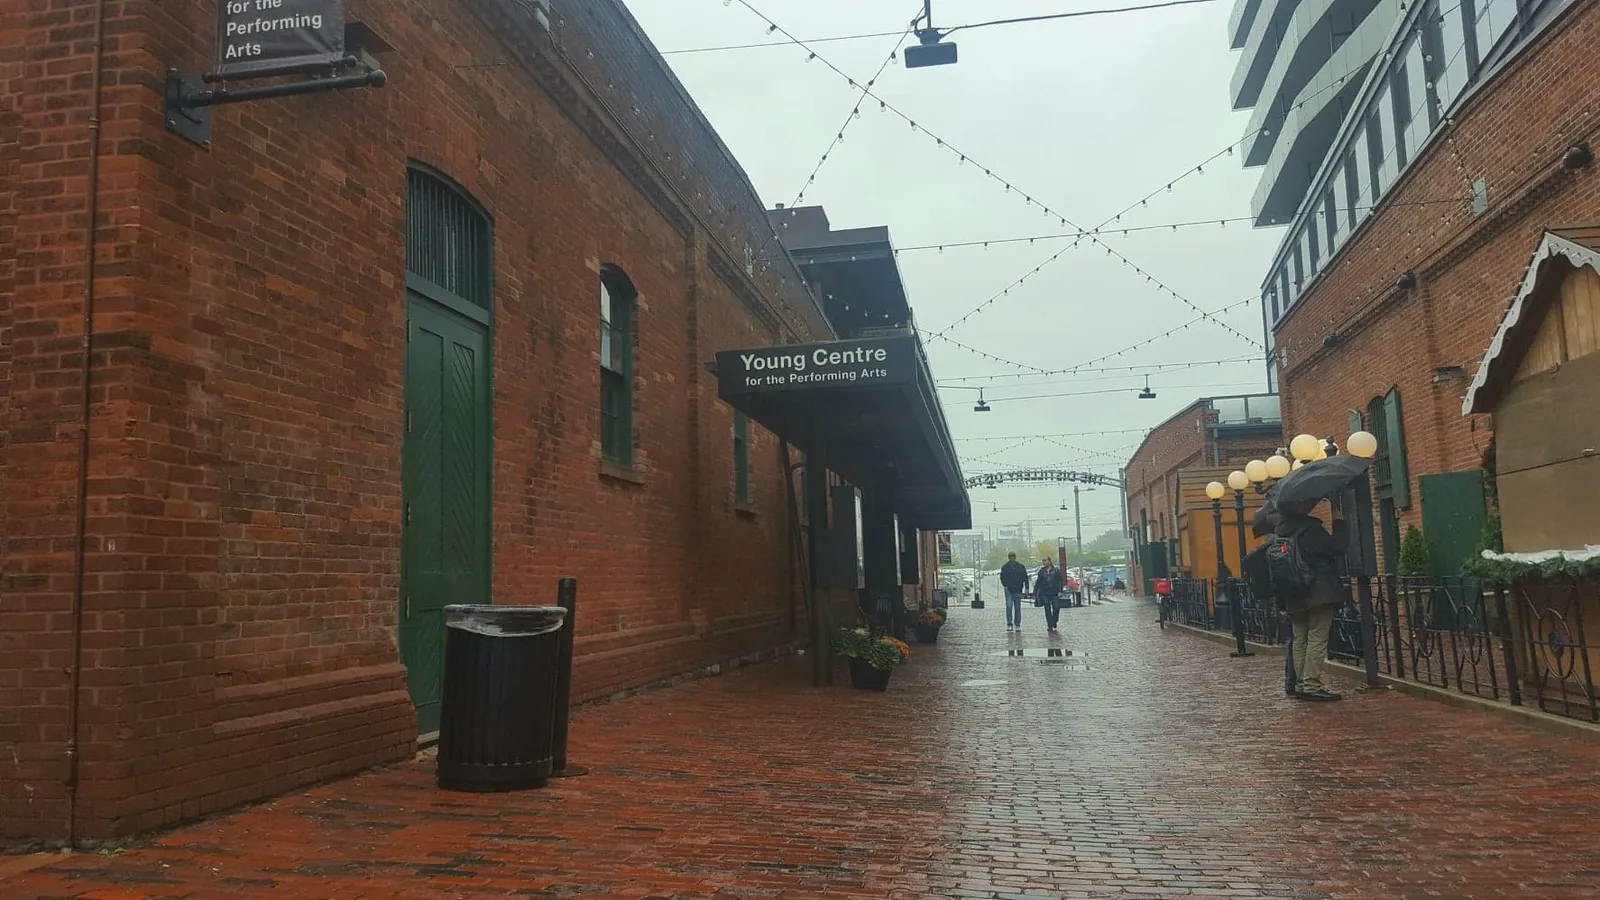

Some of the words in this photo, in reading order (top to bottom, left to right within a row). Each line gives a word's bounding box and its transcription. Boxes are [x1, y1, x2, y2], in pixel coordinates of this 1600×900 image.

[226, 1, 250, 15] for
[255, 0, 282, 10] the
[226, 13, 322, 37] Performing
[225, 42, 262, 59] Arts
[740, 353, 806, 371] Young
[813, 346, 887, 366] Centre
[745, 376, 762, 386] for
[766, 374, 785, 385] the
[790, 370, 857, 383] Performing
[861, 368, 887, 379] Arts
